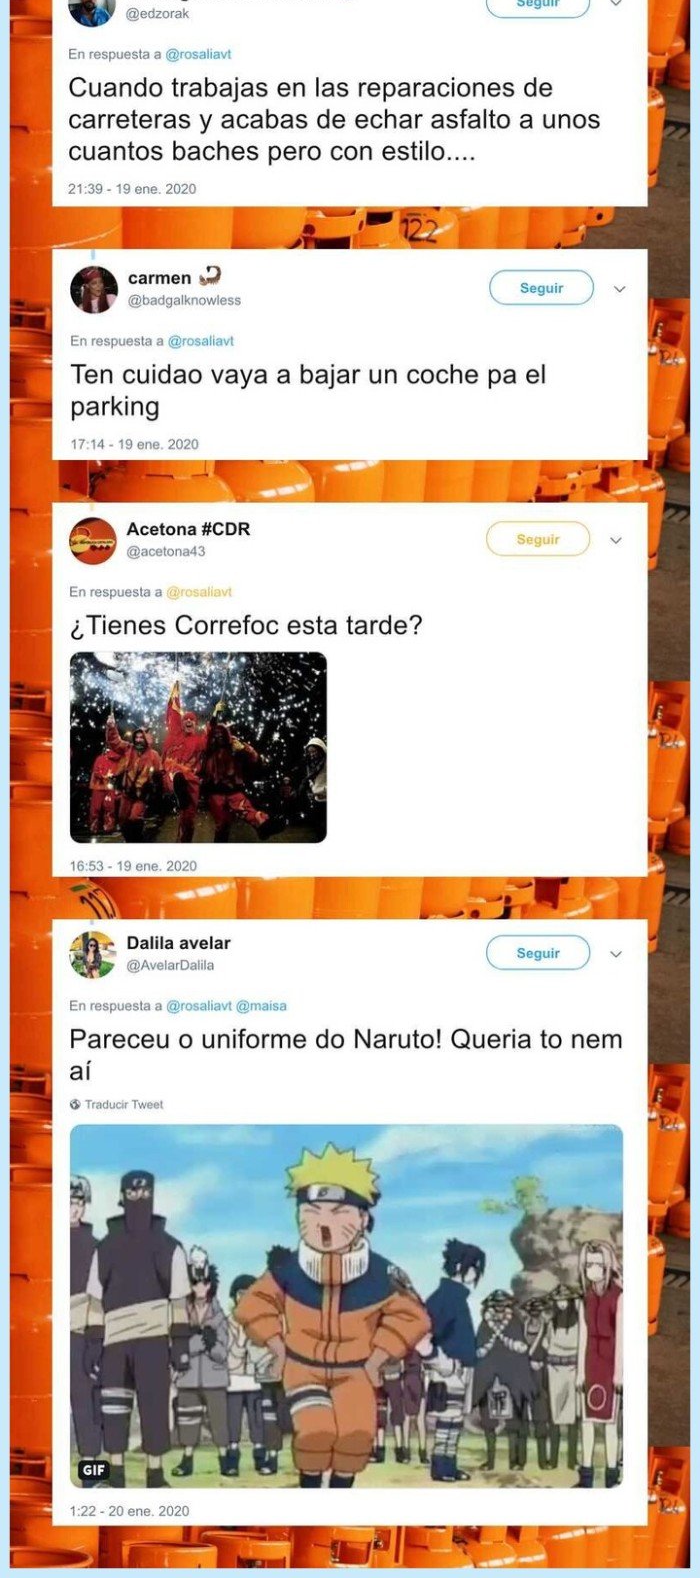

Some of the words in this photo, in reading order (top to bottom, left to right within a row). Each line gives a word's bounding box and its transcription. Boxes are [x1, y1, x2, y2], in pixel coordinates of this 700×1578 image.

[126, 8, 189, 21] @edzorak
[69, 77, 163, 97] Cuando
[171, 77, 268, 103] trabajas
[277, 82, 305, 97] en
[316, 77, 349, 97] las
[359, 77, 515, 102] reparaciones
[524, 77, 552, 97] de
[69, 109, 191, 129] carreteras
[199, 114, 212, 134] y
[221, 109, 308, 129] acabas
[317, 109, 346, 129] de
[355, 108, 423, 129] echar
[431, 108, 510, 129] asfalto
[520, 114, 533, 129] a
[543, 114, 600, 129] unos
[69, 141, 163, 161] cuantos
[173, 140, 259, 161] baches
[269, 145, 321, 166] pero
[330, 145, 372, 161] con
[382, 140, 474, 161] estilo....
[400, 217, 438, 243] 122
[128, 274, 191, 284] carmen
[128, 294, 241, 308] @badgalknowless
[70, 364, 113, 384] Ten
[123, 364, 202, 384] cuidao
[211, 369, 267, 389] vaya
[277, 369, 290, 384] a
[300, 364, 361, 389] bajar
[369, 369, 397, 384] un
[407, 364, 478, 384] coche
[488, 369, 516, 389] pa
[526, 364, 545, 384] el
[72, 396, 159, 421] parking
[126, 522, 197, 536] Acetona
[202, 522, 250, 536] #CDR
[517, 533, 560, 548] Seguir
[127, 546, 205, 559] @acetona43
[71, 615, 166, 640] ¿Tienes
[175, 614, 278, 635] Correfoc
[287, 615, 337, 635] esta
[346, 614, 422, 635] tarde?
[127, 936, 173, 950] Dalila
[180, 936, 231, 950] avelar
[517, 948, 560, 961] Seguir
[127, 960, 214, 973] @AvelarDalila
[70, 1000, 85, 1011] En
[90, 1001, 150, 1013] respuesta
[155, 1003, 162, 1011] a
[167, 1000, 232, 1014] @rosaliavt
[236, 1000, 286, 1014] @maisa
[71, 1029, 169, 1049] Pareceu
[179, 1034, 193, 1049] o
[202, 1028, 306, 1049] uniforme
[316, 1029, 344, 1049] do
[355, 1029, 441, 1049] Naruto!
[451, 1028, 531, 1050] Queria
[540, 1030, 562, 1049] to
[572, 1033, 622, 1049] nem
[70, 1060, 91, 1081] aí
[83, 1465, 105, 1475] GIF
